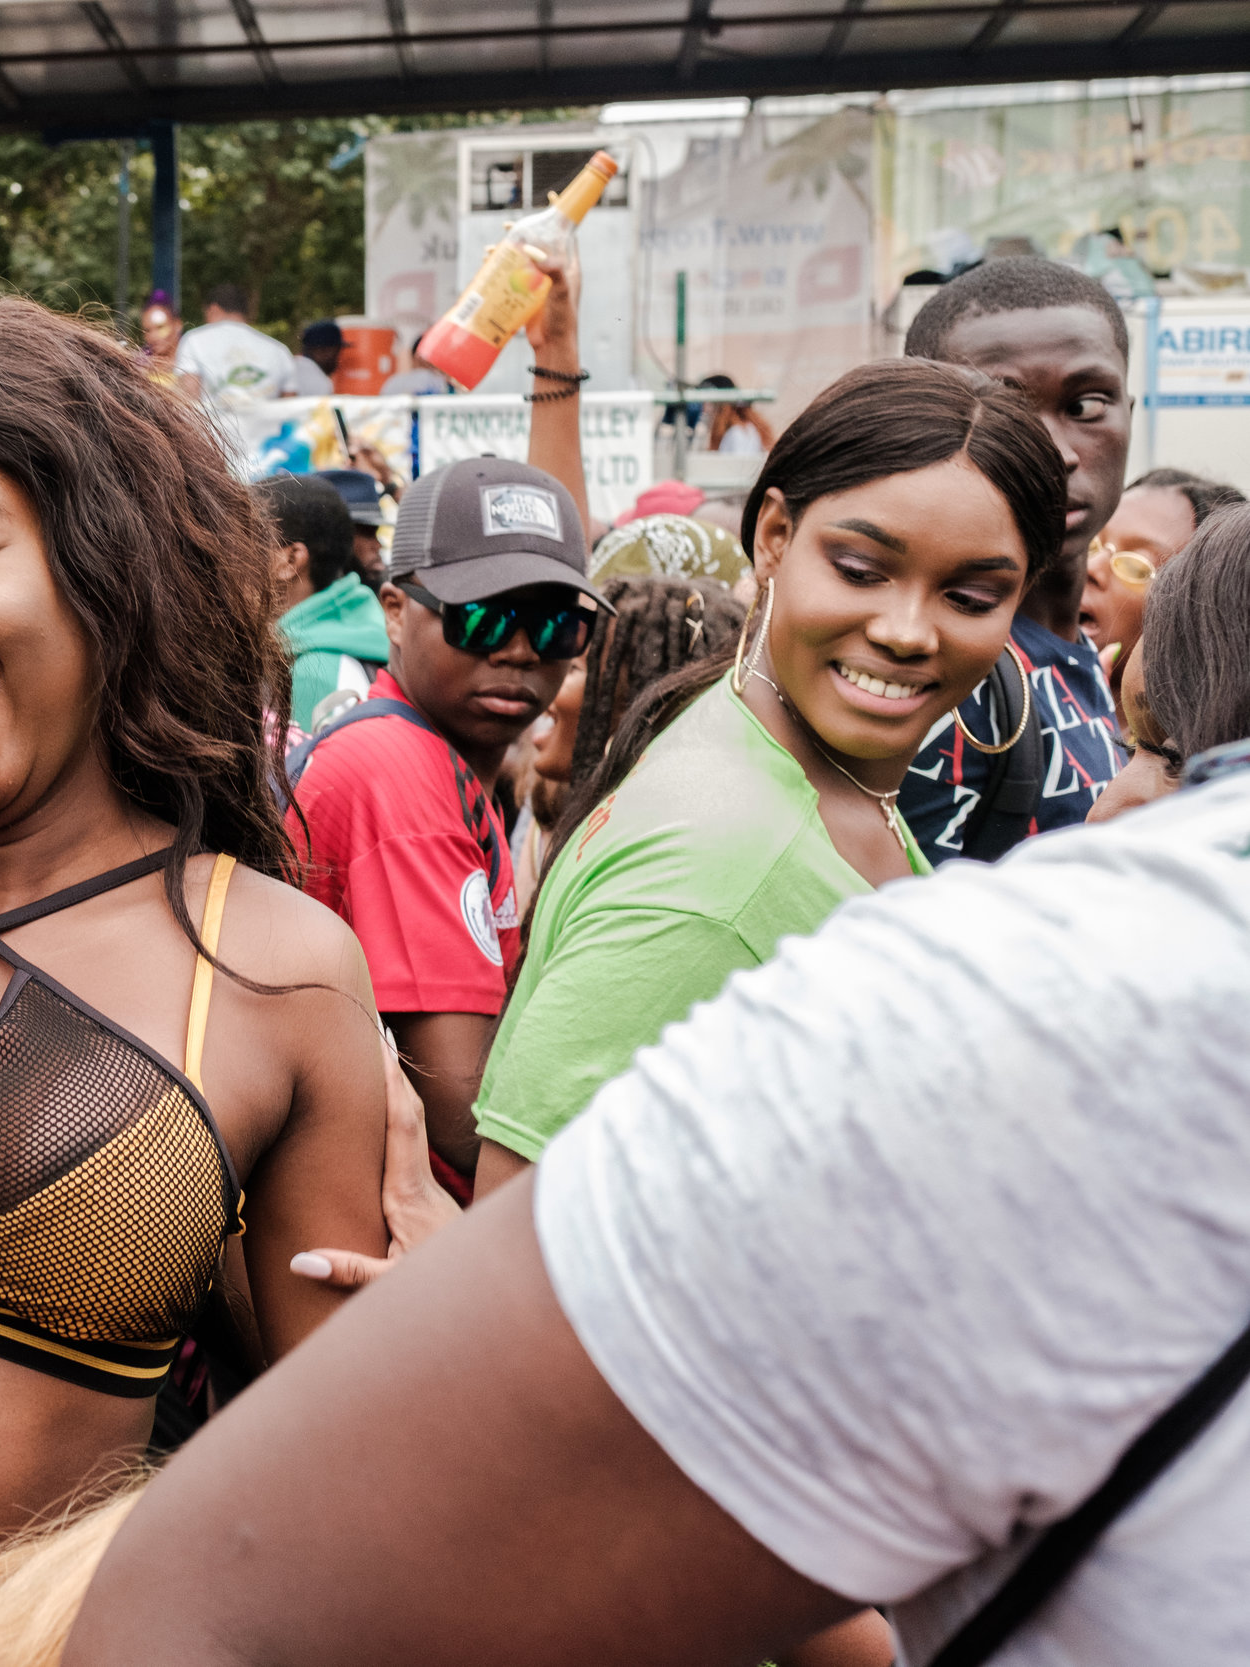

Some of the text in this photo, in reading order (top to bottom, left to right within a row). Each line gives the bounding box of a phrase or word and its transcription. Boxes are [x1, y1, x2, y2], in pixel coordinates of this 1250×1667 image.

[599, 455, 639, 485] LTD
[512, 493, 535, 505] THE
[491, 502, 536, 516] NORTH
[504, 512, 536, 523] FACE
